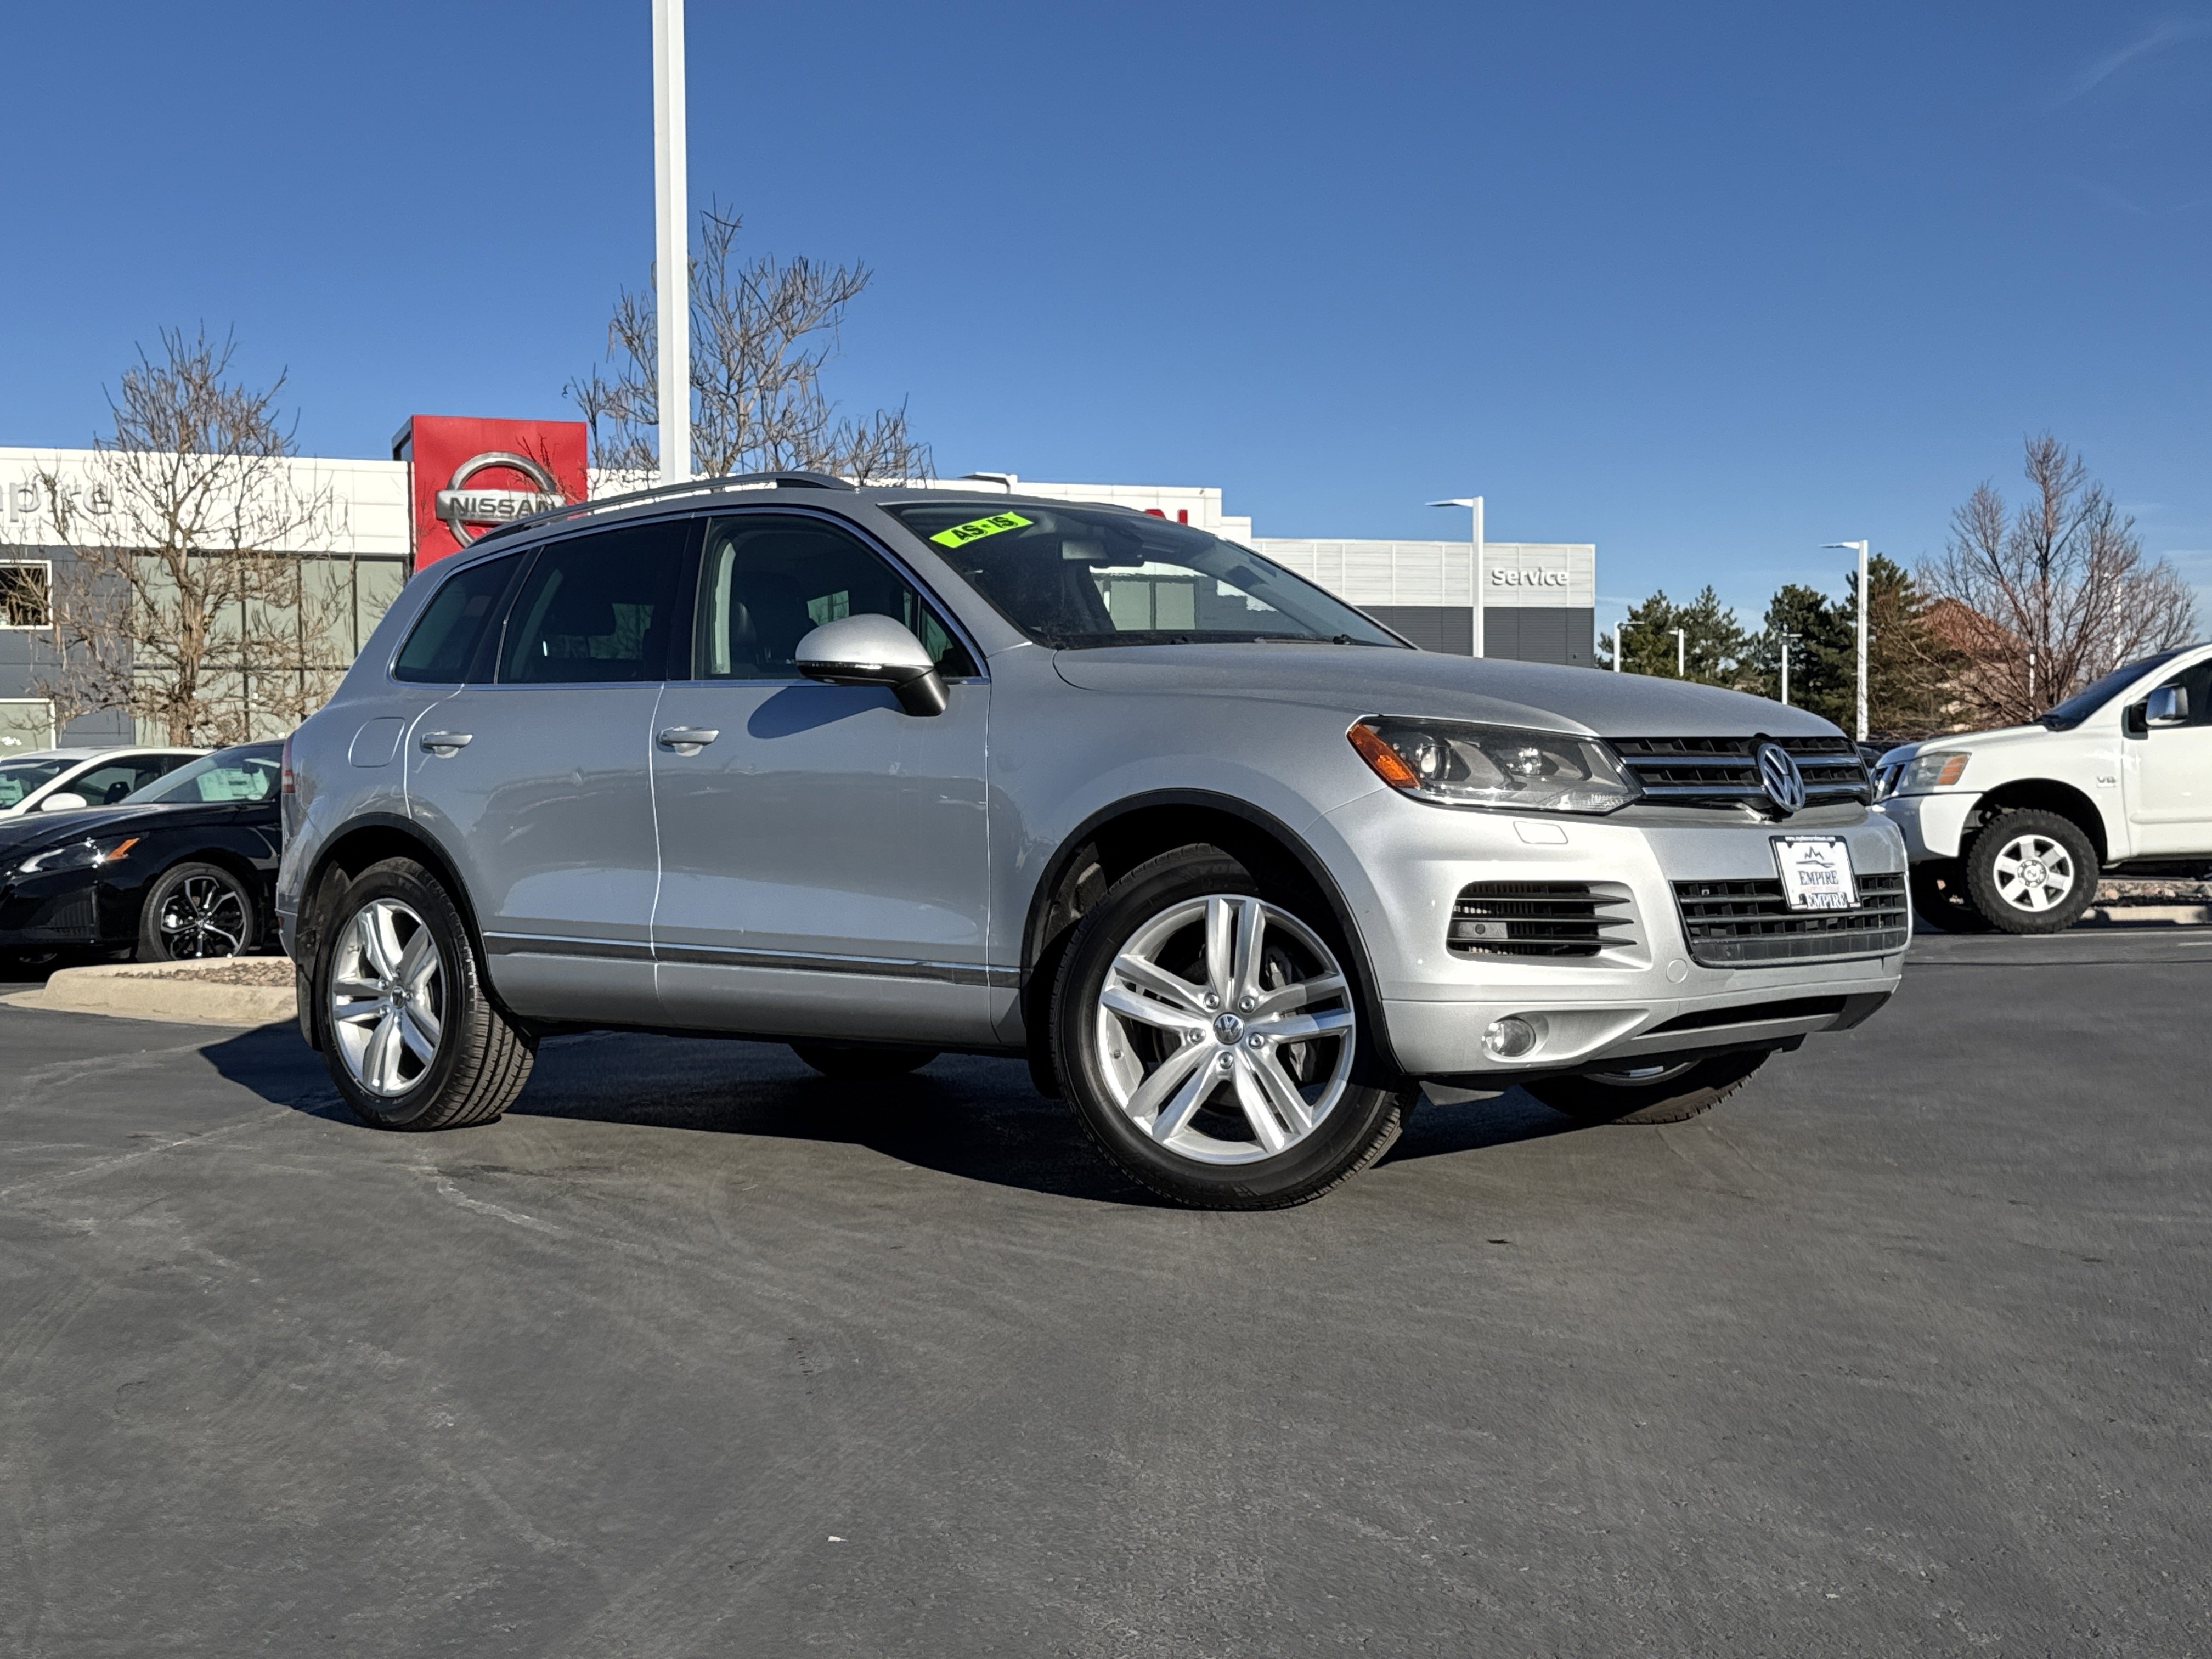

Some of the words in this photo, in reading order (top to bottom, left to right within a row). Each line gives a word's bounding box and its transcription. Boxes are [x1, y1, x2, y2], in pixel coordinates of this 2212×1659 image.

[449, 498, 556, 516] NISSAN
[951, 517, 1018, 541] AS-IS
[1492, 566, 1568, 586] Service
[1798, 870, 1839, 885] EMPIRE
[1805, 893, 1848, 909] EMPIRE
